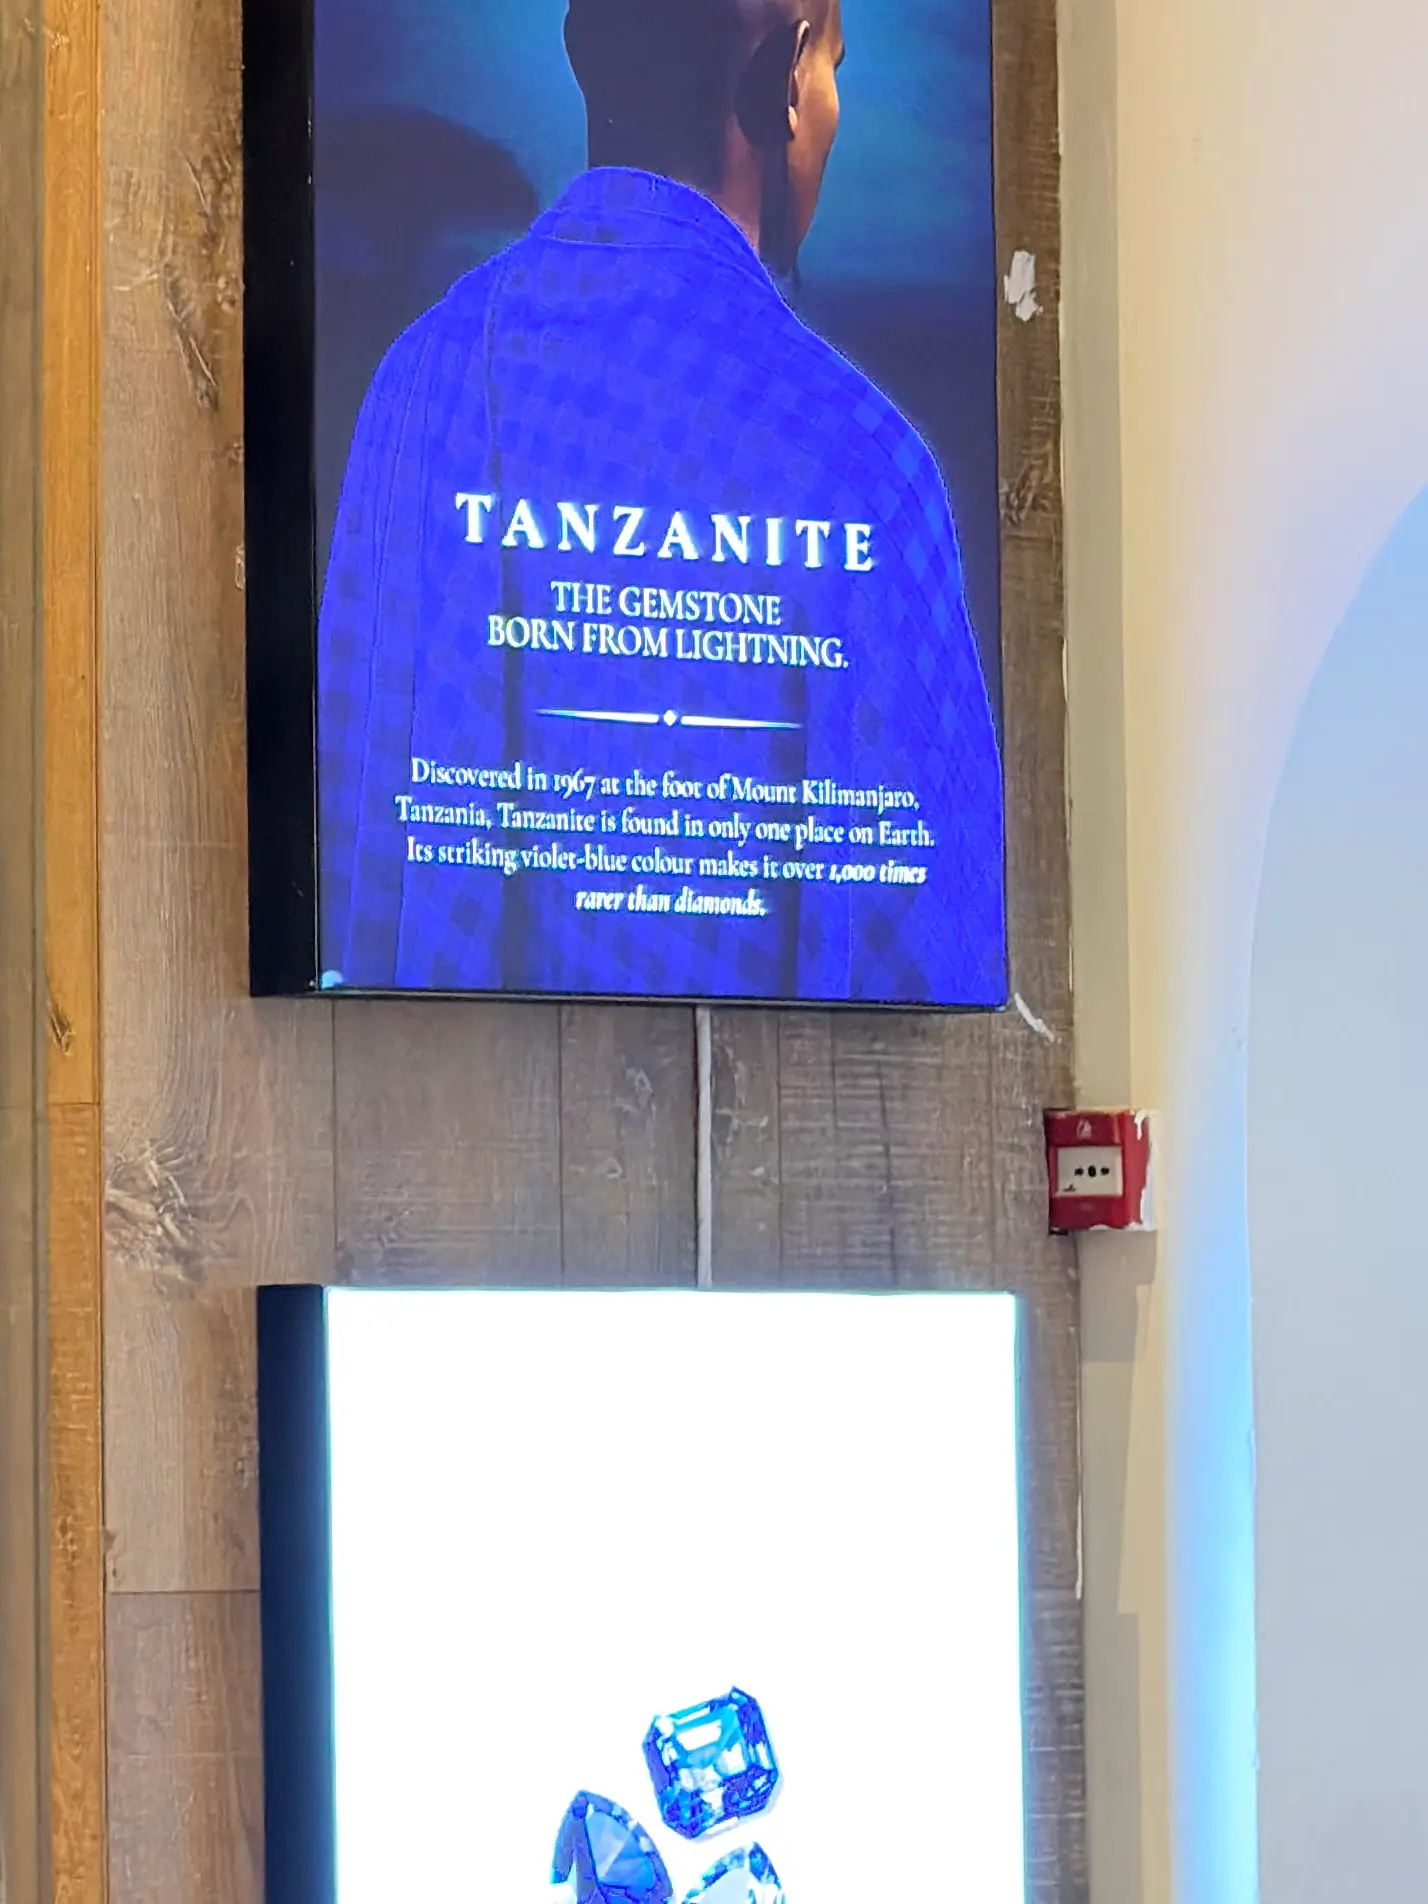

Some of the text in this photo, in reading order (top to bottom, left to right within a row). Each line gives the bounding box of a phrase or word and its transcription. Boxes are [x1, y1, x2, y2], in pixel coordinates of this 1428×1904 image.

[455, 492, 874, 571] TANZANITE
[550, 580, 782, 626] THE GEMSTONE
[487, 614, 850, 669] BORN FROM LIGHTNING.
[411, 757, 920, 815] Discovered in 1967 at the foot of Mount Kilimanjaro,
[395, 795, 935, 850] Tanzania, Tanzanite is found in only one place on Earth.
[407, 835, 927, 884] Its striking violet-blue colour makes it over 1,000 times
[574, 884, 767, 917] rarer than diamonds.
